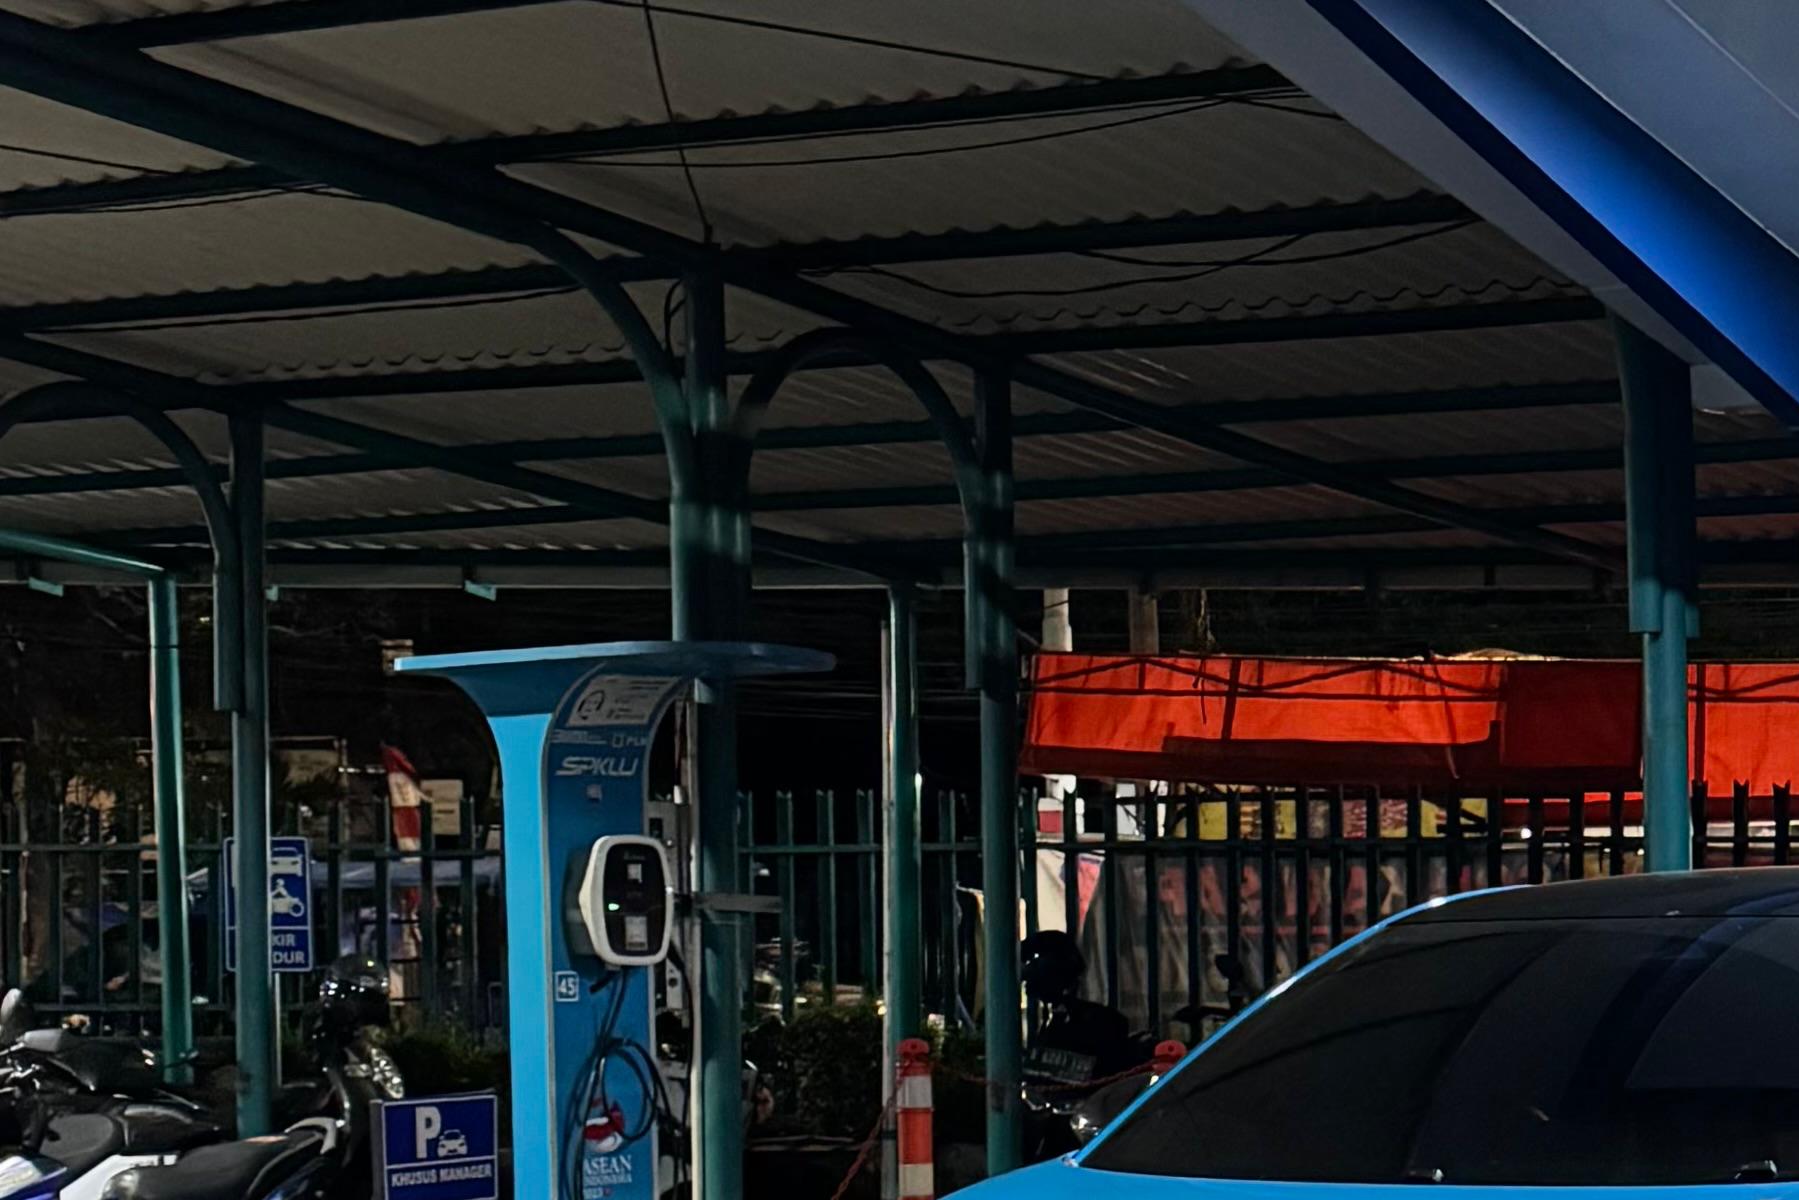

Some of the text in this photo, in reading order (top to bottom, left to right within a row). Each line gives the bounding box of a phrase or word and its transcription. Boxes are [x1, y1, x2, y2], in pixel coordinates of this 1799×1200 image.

[555, 756, 639, 776] SPKLU
[560, 977, 576, 996] 45
[416, 1106, 441, 1159] P
[392, 1163, 492, 1187] KHUSUS MANAGER
[583, 1154, 632, 1176] ASEAN
